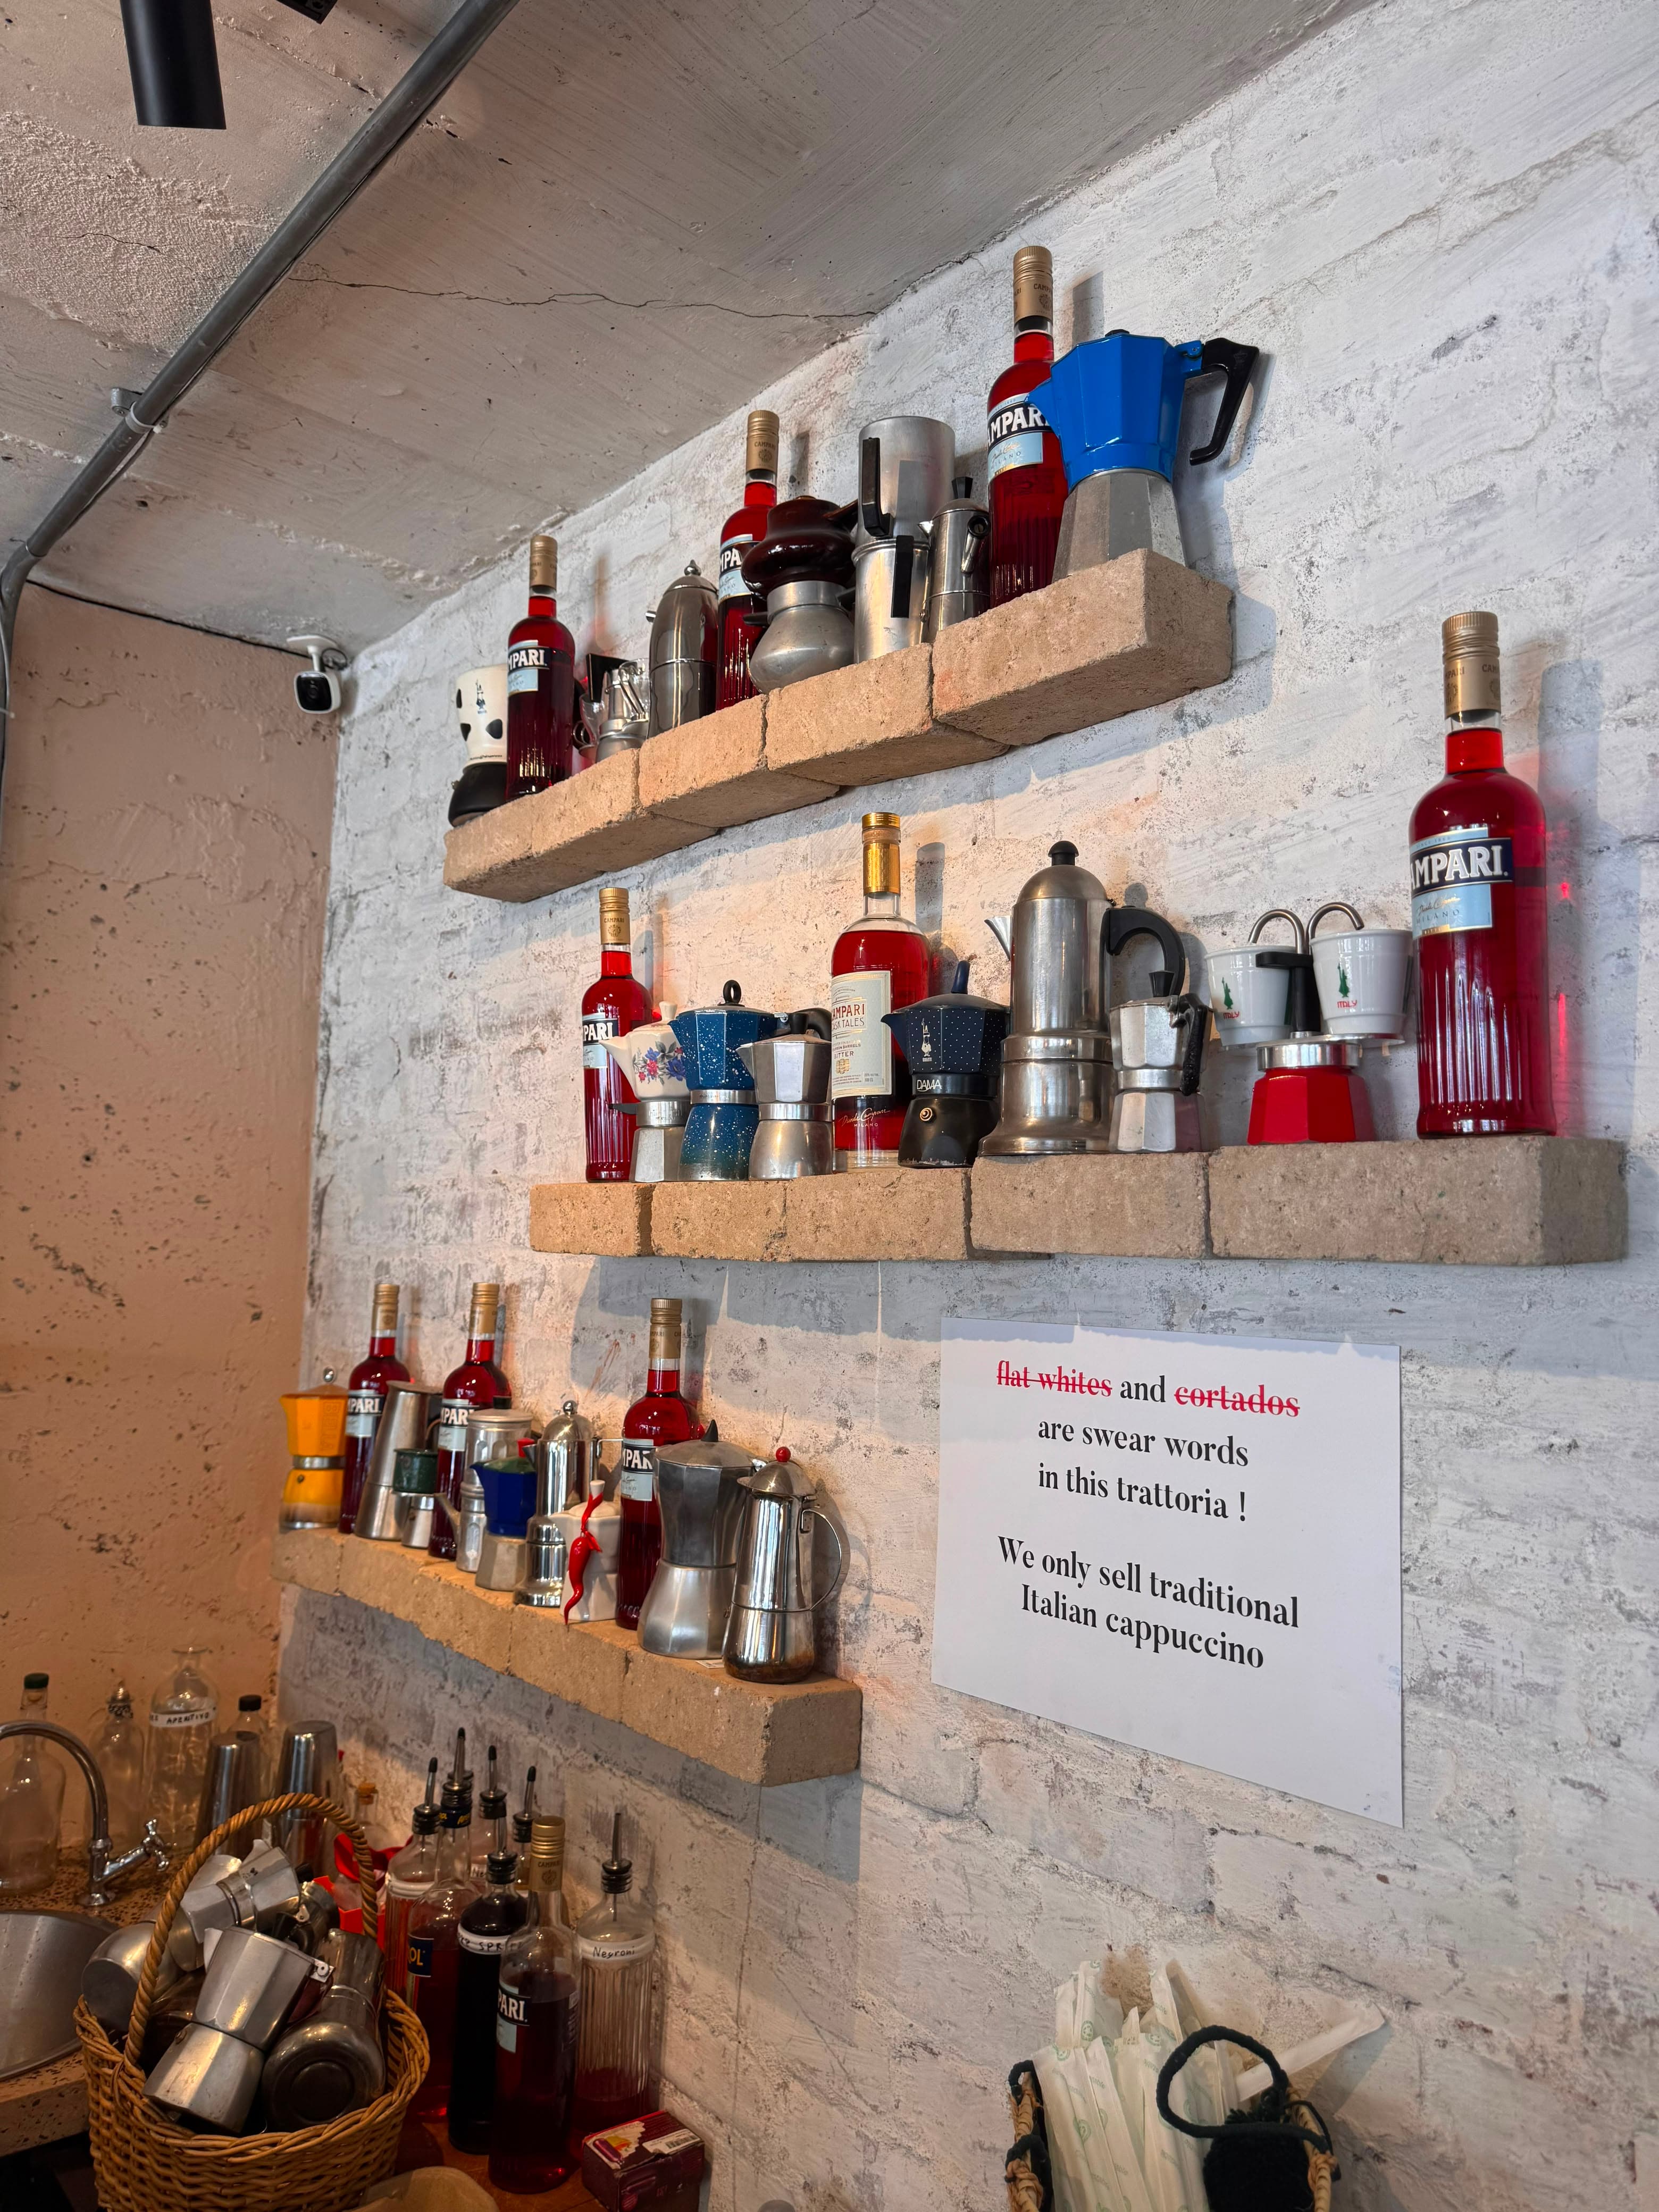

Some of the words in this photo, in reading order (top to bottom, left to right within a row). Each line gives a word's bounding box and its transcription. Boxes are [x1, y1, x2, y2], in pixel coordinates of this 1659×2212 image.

[842, 1017, 865, 1028] TALES
[1224, 1011, 1239, 1019] ITALY
[1337, 1000, 1357, 1008] ITALY
[917, 1079, 942, 1091] DAMA
[996, 1360, 1030, 1389] flat
[1037, 1366, 1112, 1397] whites
[1120, 1375, 1166, 1403] and
[1174, 1384, 1300, 1417] cortados
[1038, 1419, 1074, 1442] are
[1083, 1425, 1155, 1453] swear
[1164, 1435, 1249, 1467] words
[1038, 1463, 1059, 1489] in
[1066, 1467, 1108, 1498] this
[1117, 1477, 1229, 1519] trattoria
[998, 1536, 1034, 1569] We
[1042, 1551, 1092, 1588] only
[1100, 1562, 1141, 1593] sell
[1150, 1572, 1298, 1628] traditional
[1021, 1583, 1097, 1628] Italian
[1106, 1612, 1264, 1669] cappuccino
